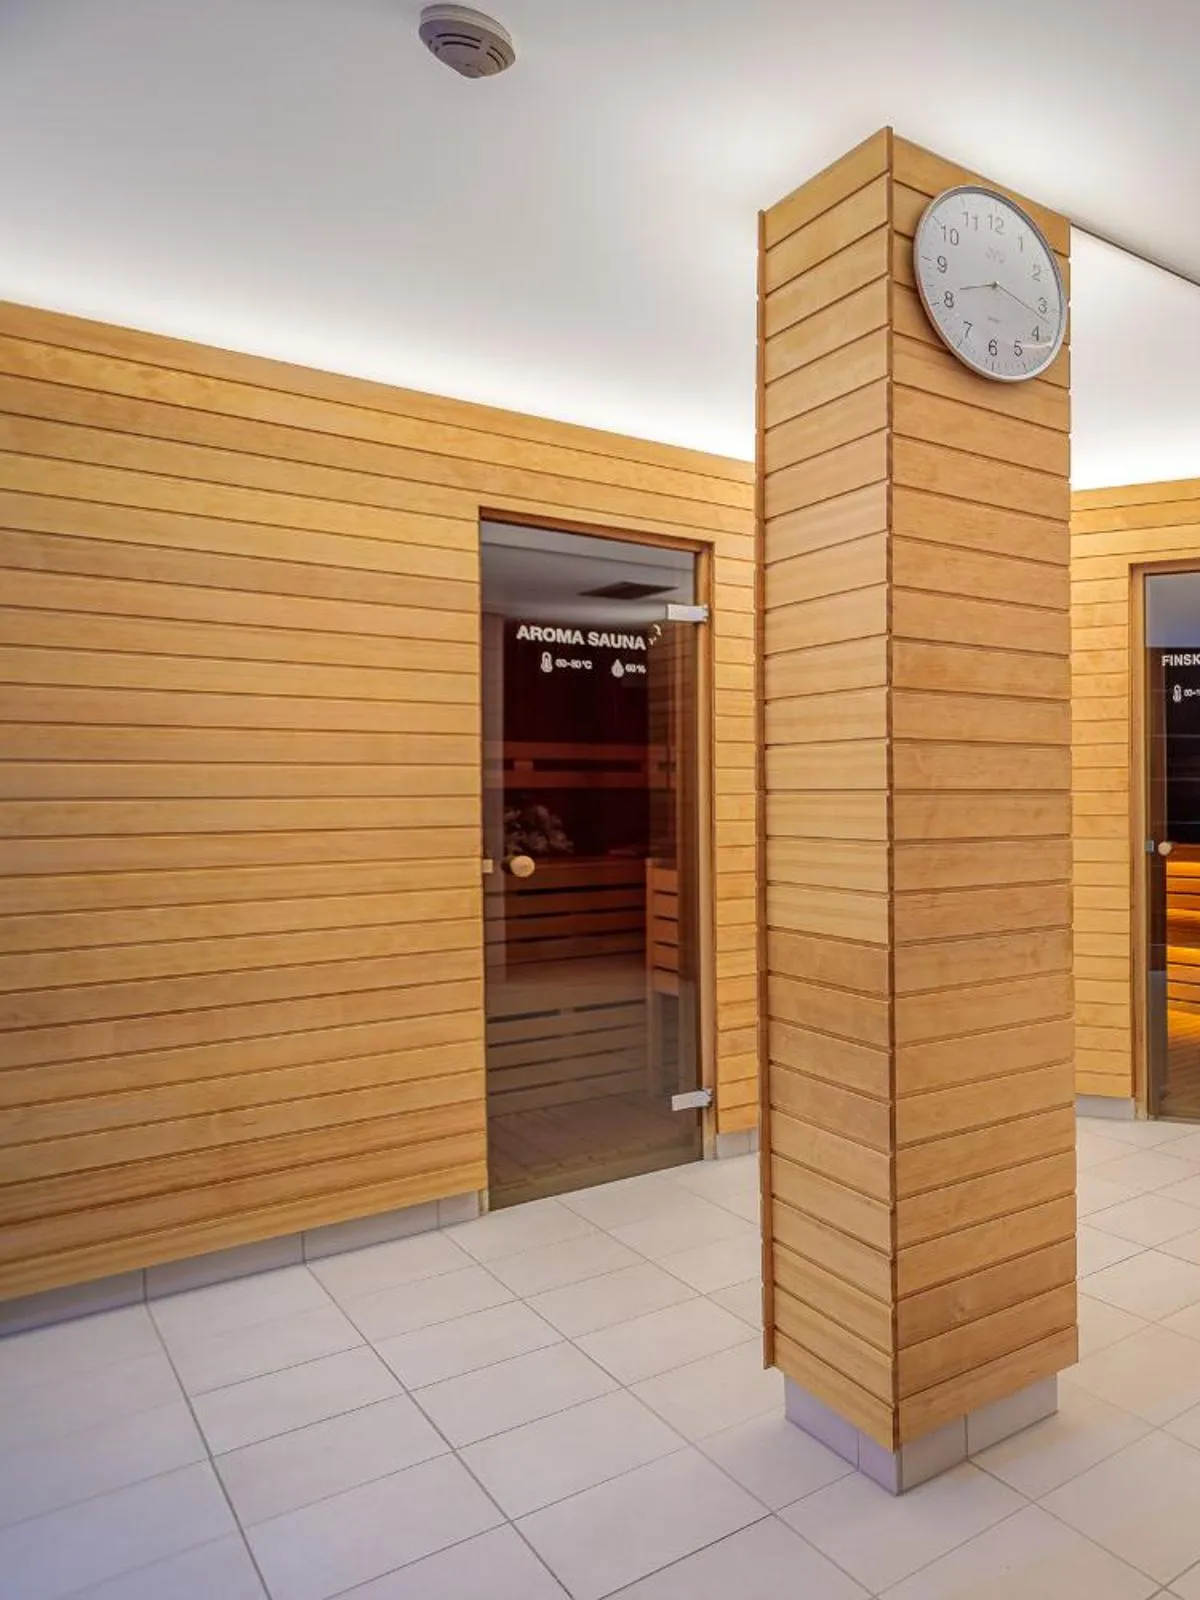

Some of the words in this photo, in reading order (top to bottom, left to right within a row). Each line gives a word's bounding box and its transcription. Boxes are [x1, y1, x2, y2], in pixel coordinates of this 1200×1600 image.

[963, 211, 979, 231] 11
[987, 213, 1005, 235] 12
[941, 225, 960, 246] 10
[1018, 235, 1024, 252] 1
[937, 255, 948, 274] 9
[1032, 263, 1042, 282] 2
[943, 290, 955, 309] 8
[1037, 296, 1048, 315] 3
[963, 320, 973, 339] 7
[1031, 325, 1040, 341] 4
[987, 338, 998, 357] 6
[1013, 340, 1023, 357] 5
[516, 624, 586, 646] AROMA
[587, 631, 647, 650] SAUNA
